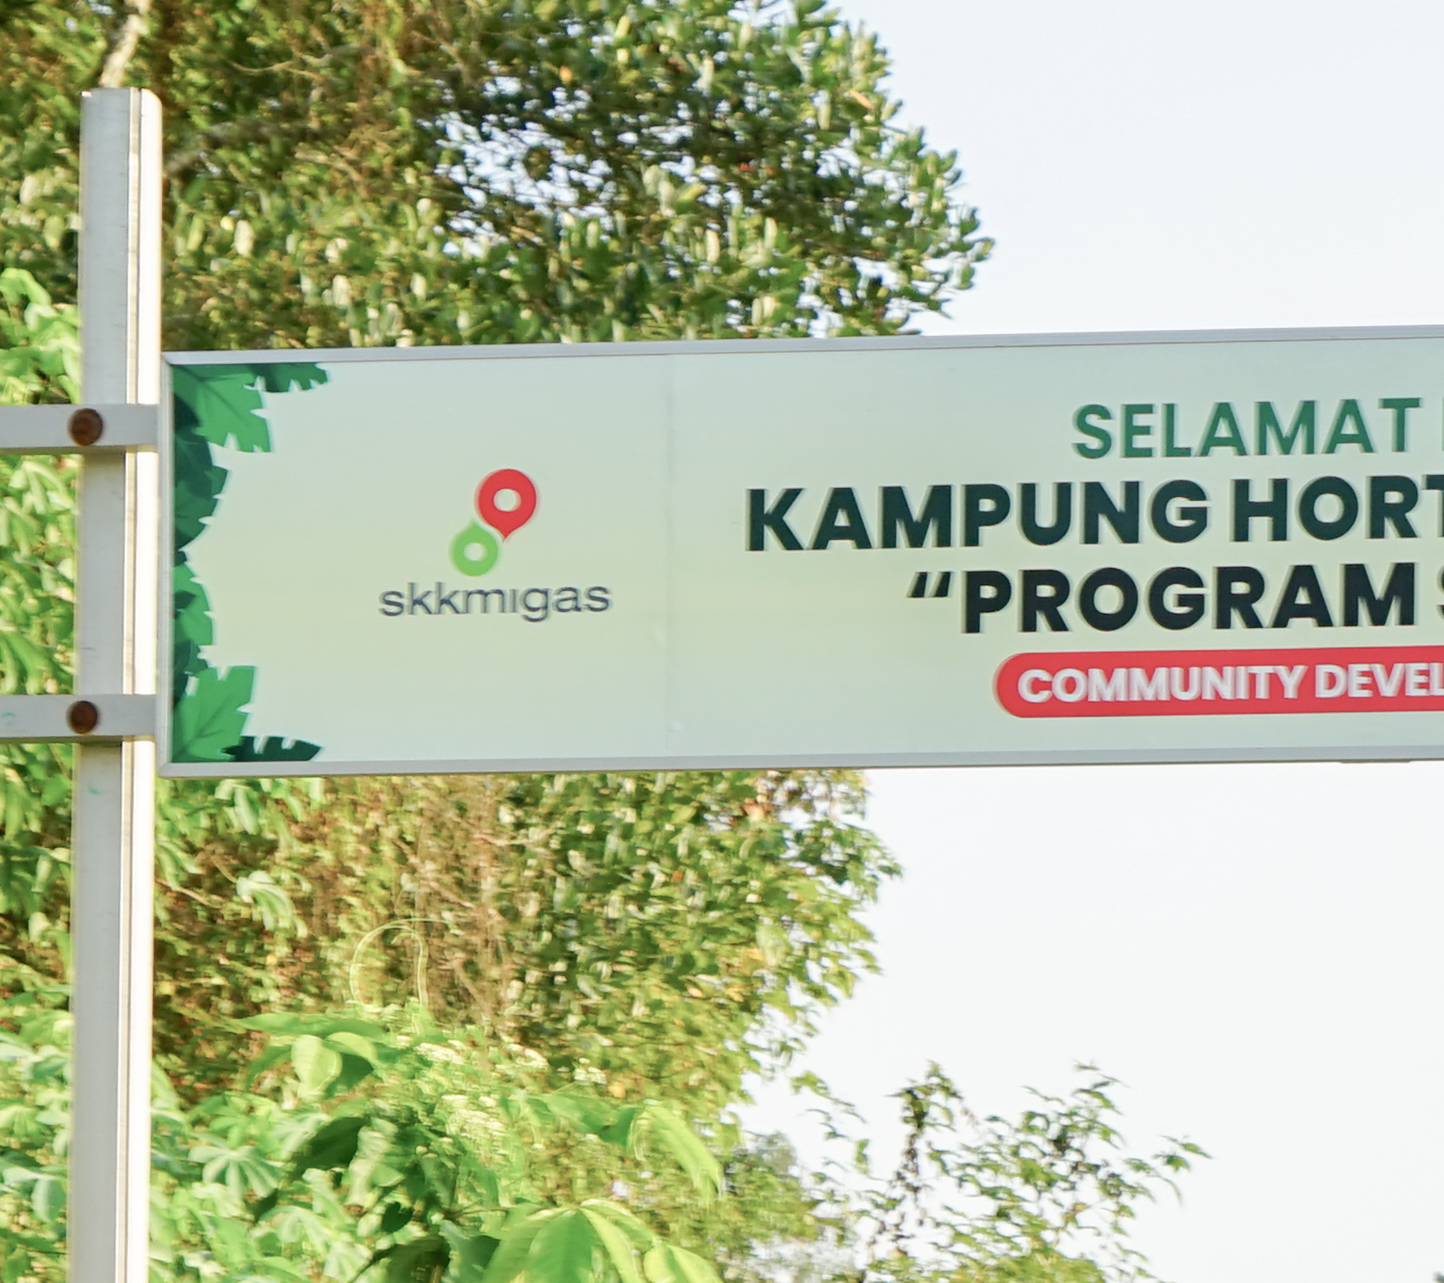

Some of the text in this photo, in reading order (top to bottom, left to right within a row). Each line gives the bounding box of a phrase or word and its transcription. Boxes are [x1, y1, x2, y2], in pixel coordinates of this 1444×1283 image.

[1074, 397, 1422, 460] SELAMAT
[746, 479, 1209, 552] KAMPUNG
[379, 581, 613, 623] skkmigas
[1017, 664, 1308, 703] COMMUNITY
